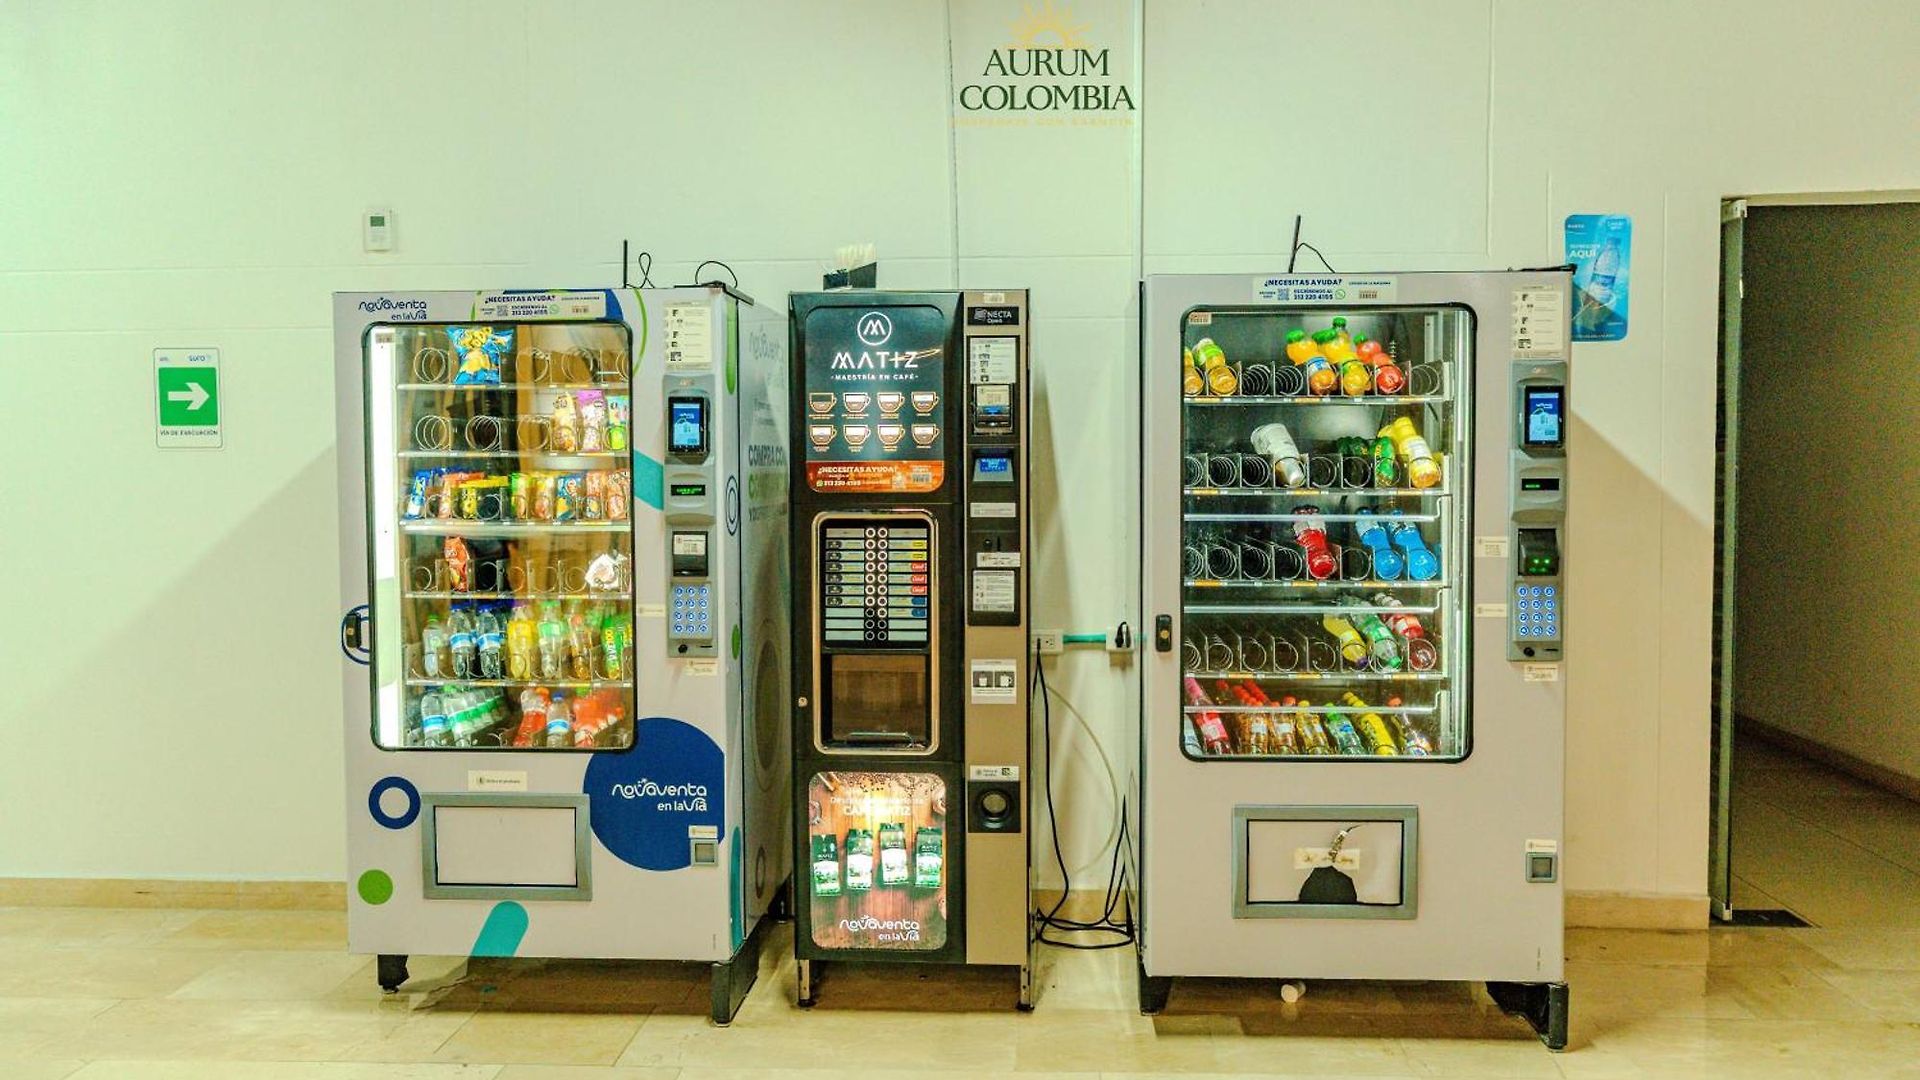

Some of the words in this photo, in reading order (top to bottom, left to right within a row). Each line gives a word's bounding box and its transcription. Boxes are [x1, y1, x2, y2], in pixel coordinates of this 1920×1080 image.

[986, 311, 1012, 319] NECTA
[831, 351, 919, 369] MATIZ
[611, 777, 707, 800] novaventa
[657, 801, 672, 812] en
